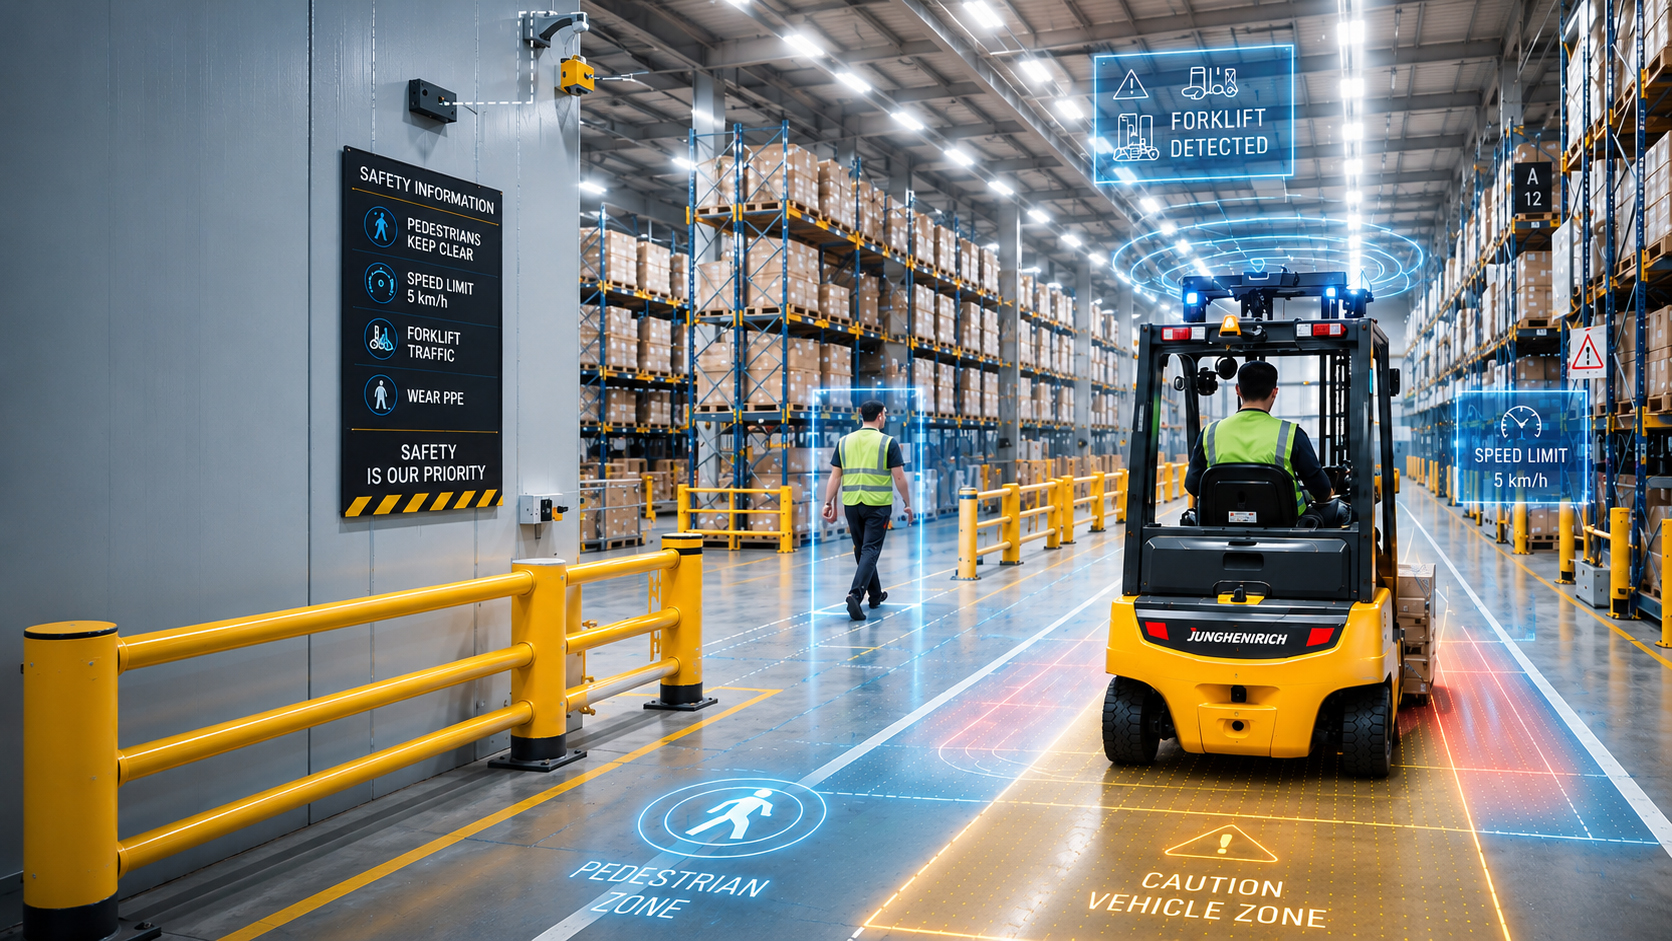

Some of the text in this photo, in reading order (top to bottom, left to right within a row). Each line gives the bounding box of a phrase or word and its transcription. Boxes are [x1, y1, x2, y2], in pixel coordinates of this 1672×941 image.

[1527, 167, 1539, 185] A
[360, 166, 495, 215] SAFETY INFORMATION
[1524, 191, 1542, 206] 12
[407, 217, 481, 247] PEDESTRIANS
[407, 235, 474, 262] KEEP CLEAR
[407, 272, 474, 295] SPEED LIMIT
[407, 289, 448, 309] 5 km/h
[407, 326, 461, 346] FORKLIFT
[407, 344, 455, 363] TRAFFIC
[407, 389, 464, 406] WEAR PPE
[401, 444, 457, 461] SAFETY
[367, 464, 486, 485] IS OUR PRIORITY
[1187, 627, 1288, 645] JUNGHENIRICH
[569, 860, 770, 898] PEDESTRIAN
[1141, 872, 1283, 898] CAUTION
[590, 891, 691, 919] ZONE
[1088, 891, 1328, 929] VEHICLE ZONE
